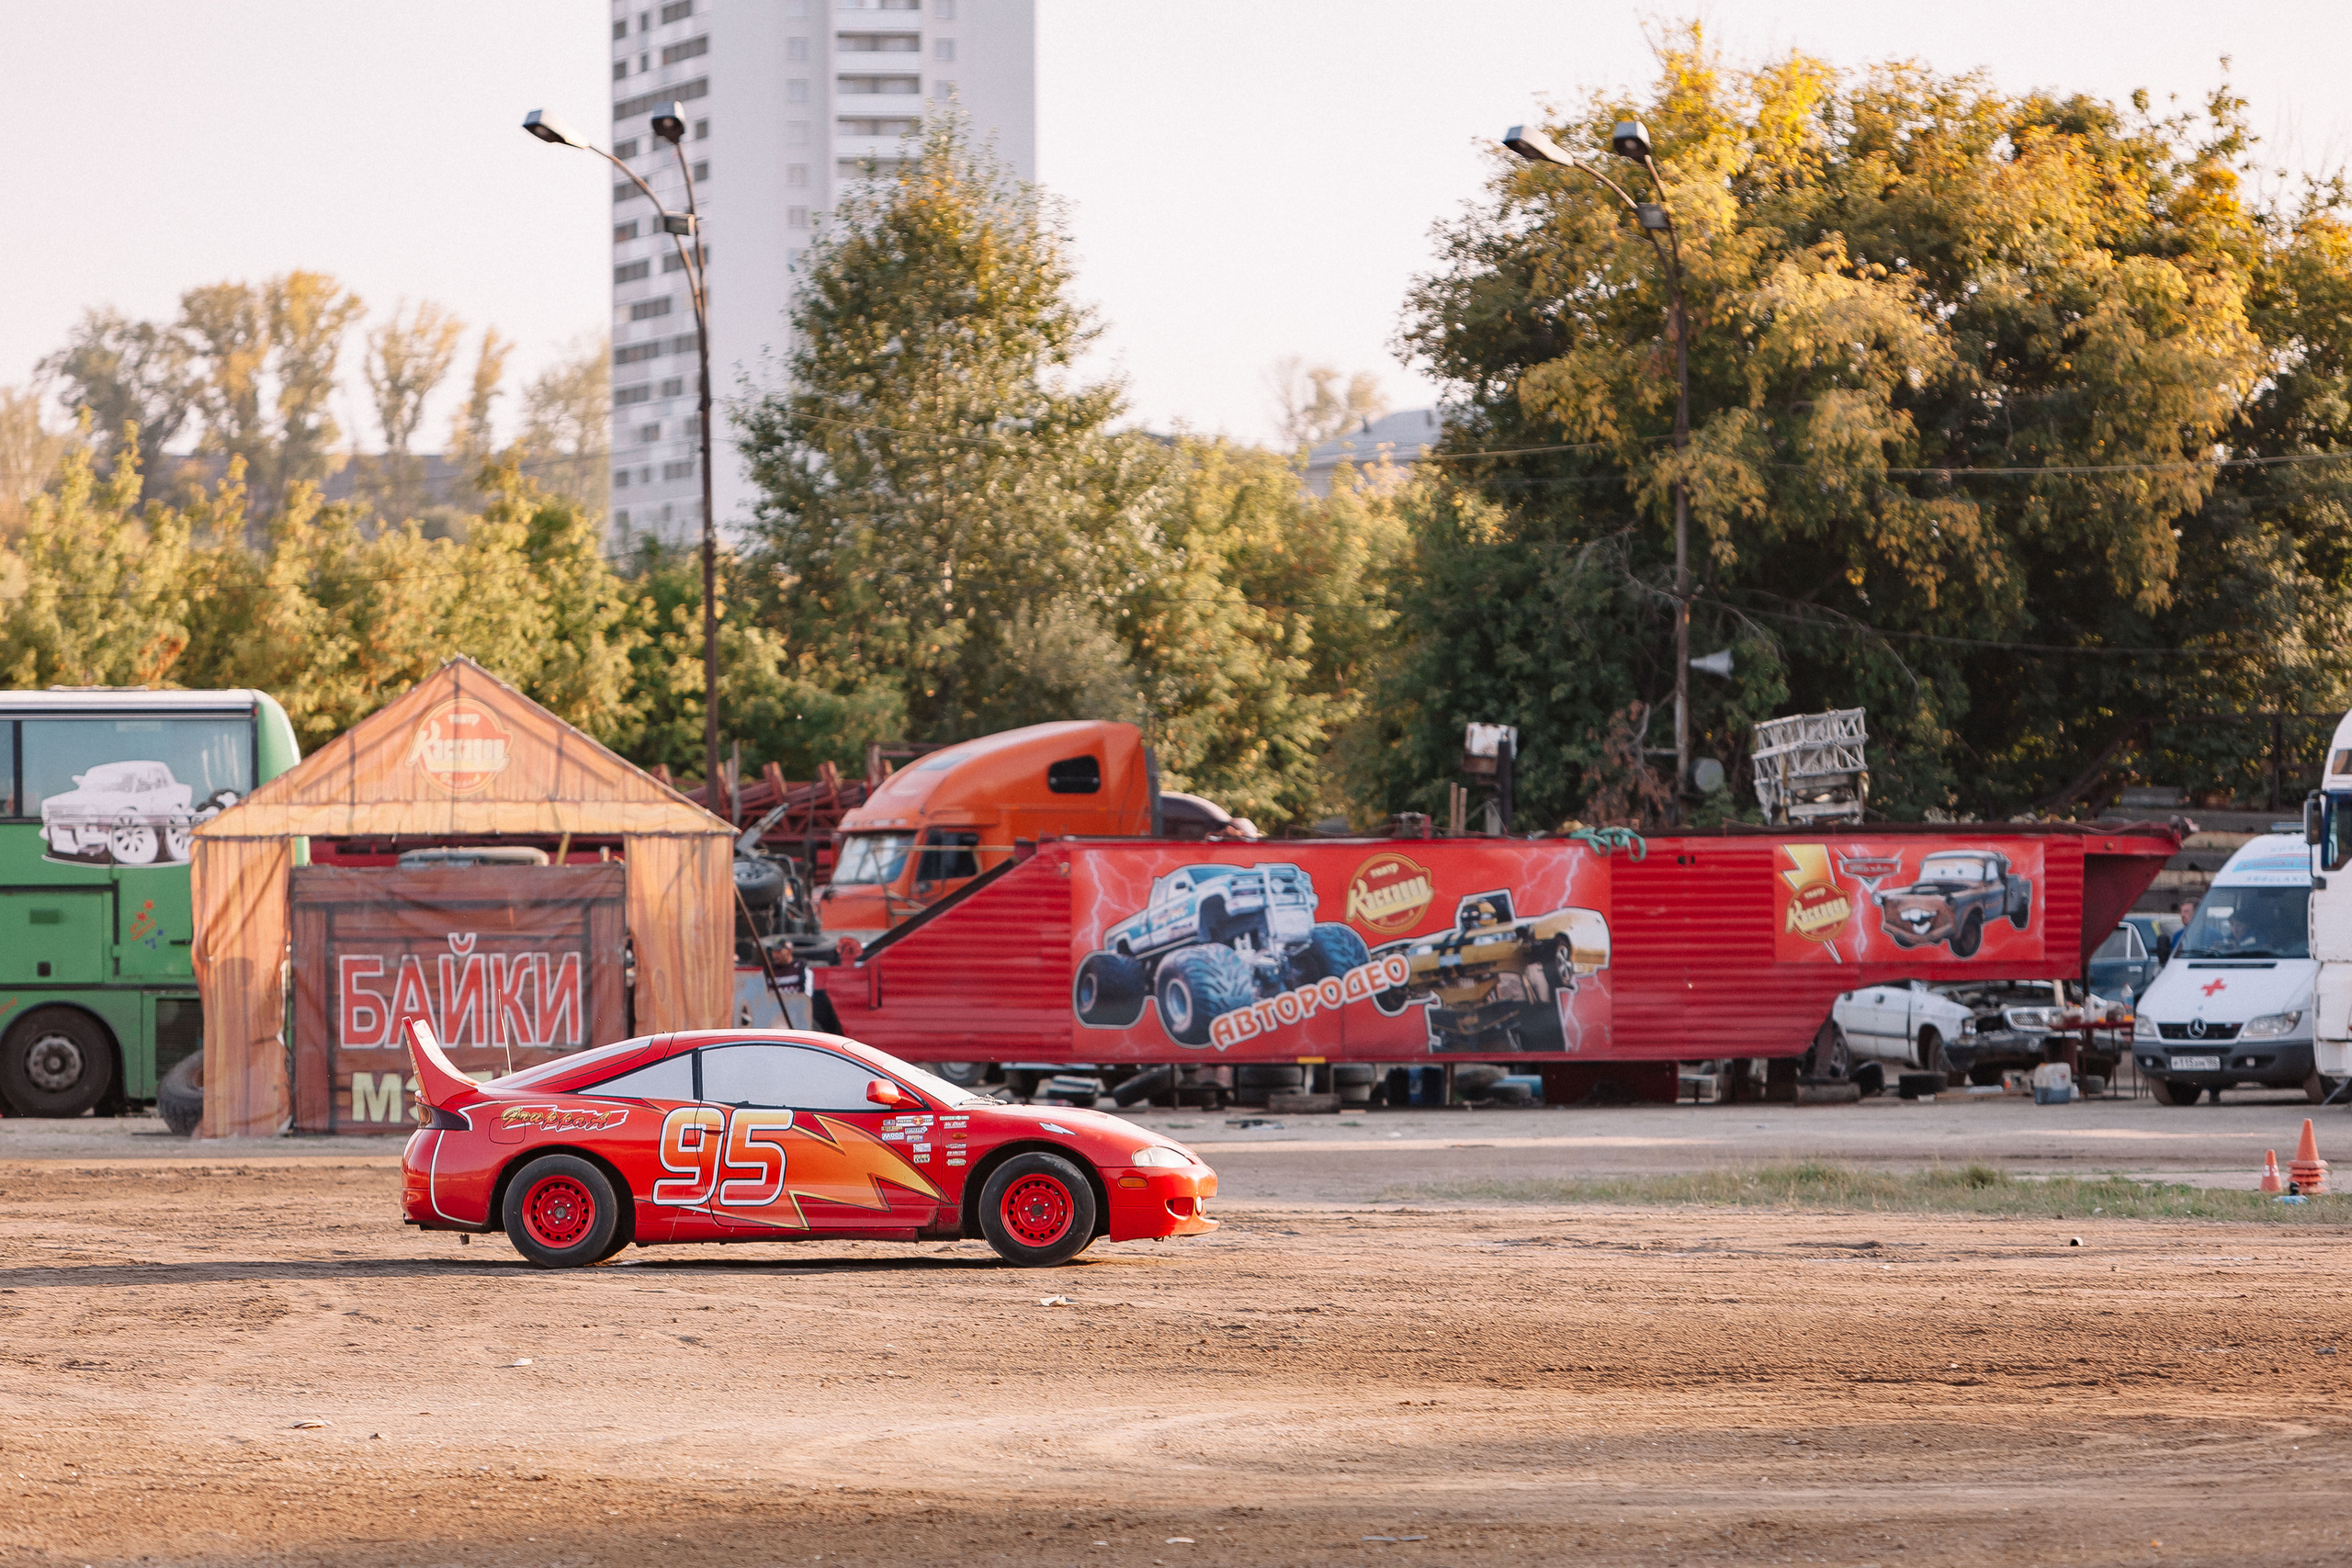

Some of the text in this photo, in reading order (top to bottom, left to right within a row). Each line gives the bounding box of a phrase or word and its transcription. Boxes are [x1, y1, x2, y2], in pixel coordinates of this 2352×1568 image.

[339, 932, 582, 1049] БАЙКИ
[1210, 953, 1410, 1052] АВТОРОДЕО
[651, 1106, 796, 1206] 95
